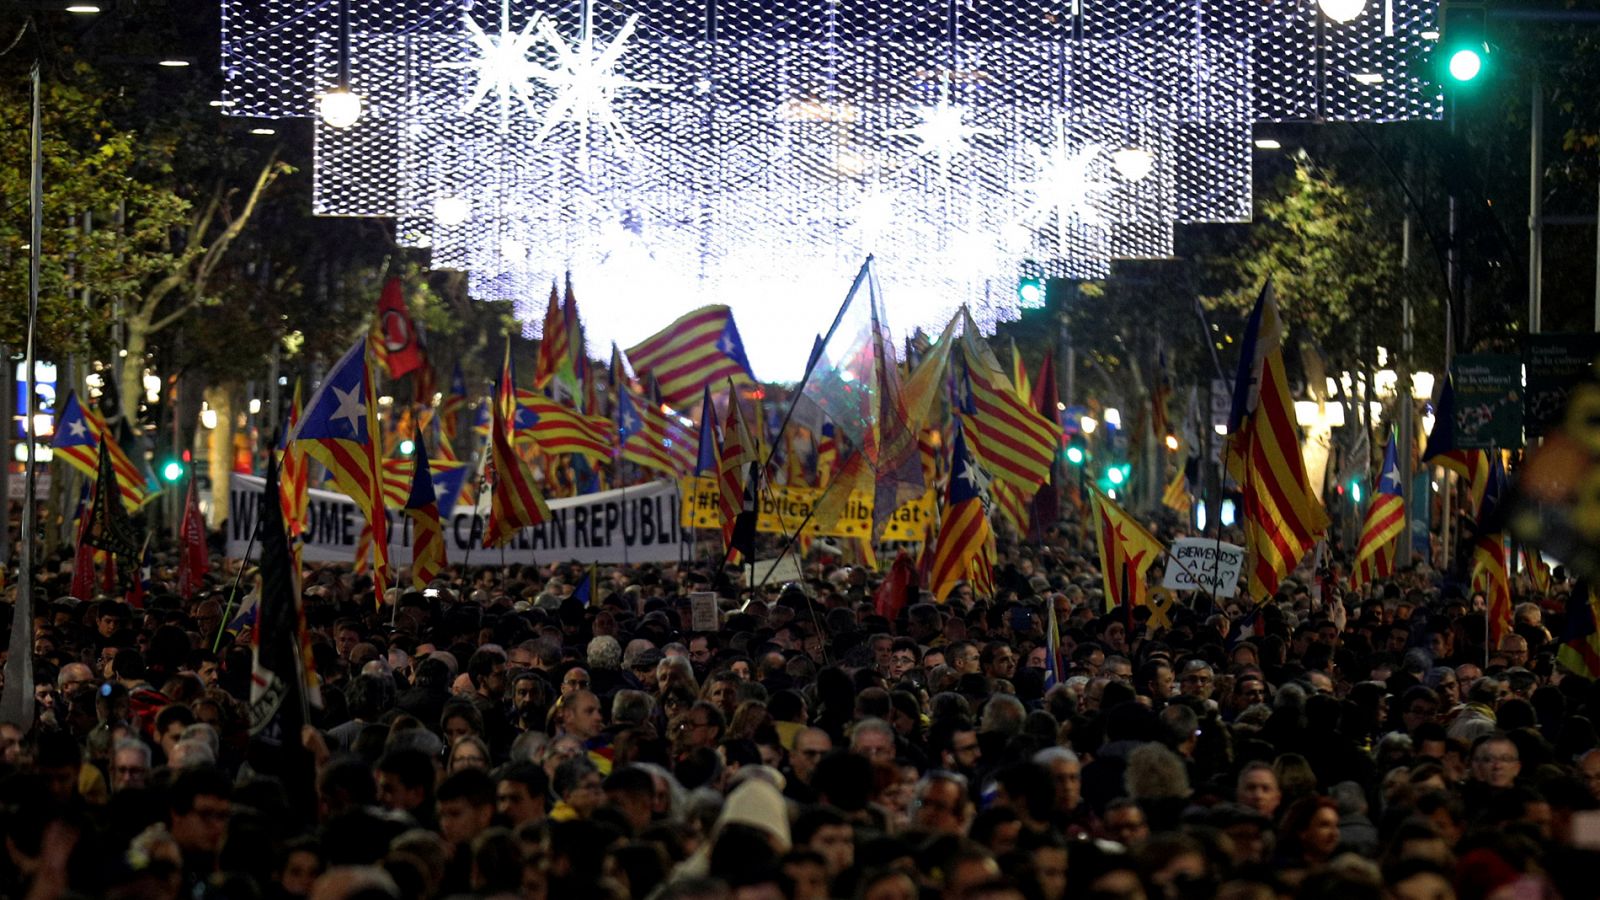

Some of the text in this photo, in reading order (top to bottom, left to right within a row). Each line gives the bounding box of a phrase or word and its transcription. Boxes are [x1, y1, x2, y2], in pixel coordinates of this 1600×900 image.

[698, 492, 810, 517] #Rblica
[231, 490, 356, 545] WEOME
[453, 506, 568, 550] CALAN
[574, 494, 693, 548] REPUBLI
[1188, 559, 1219, 572] A LA
